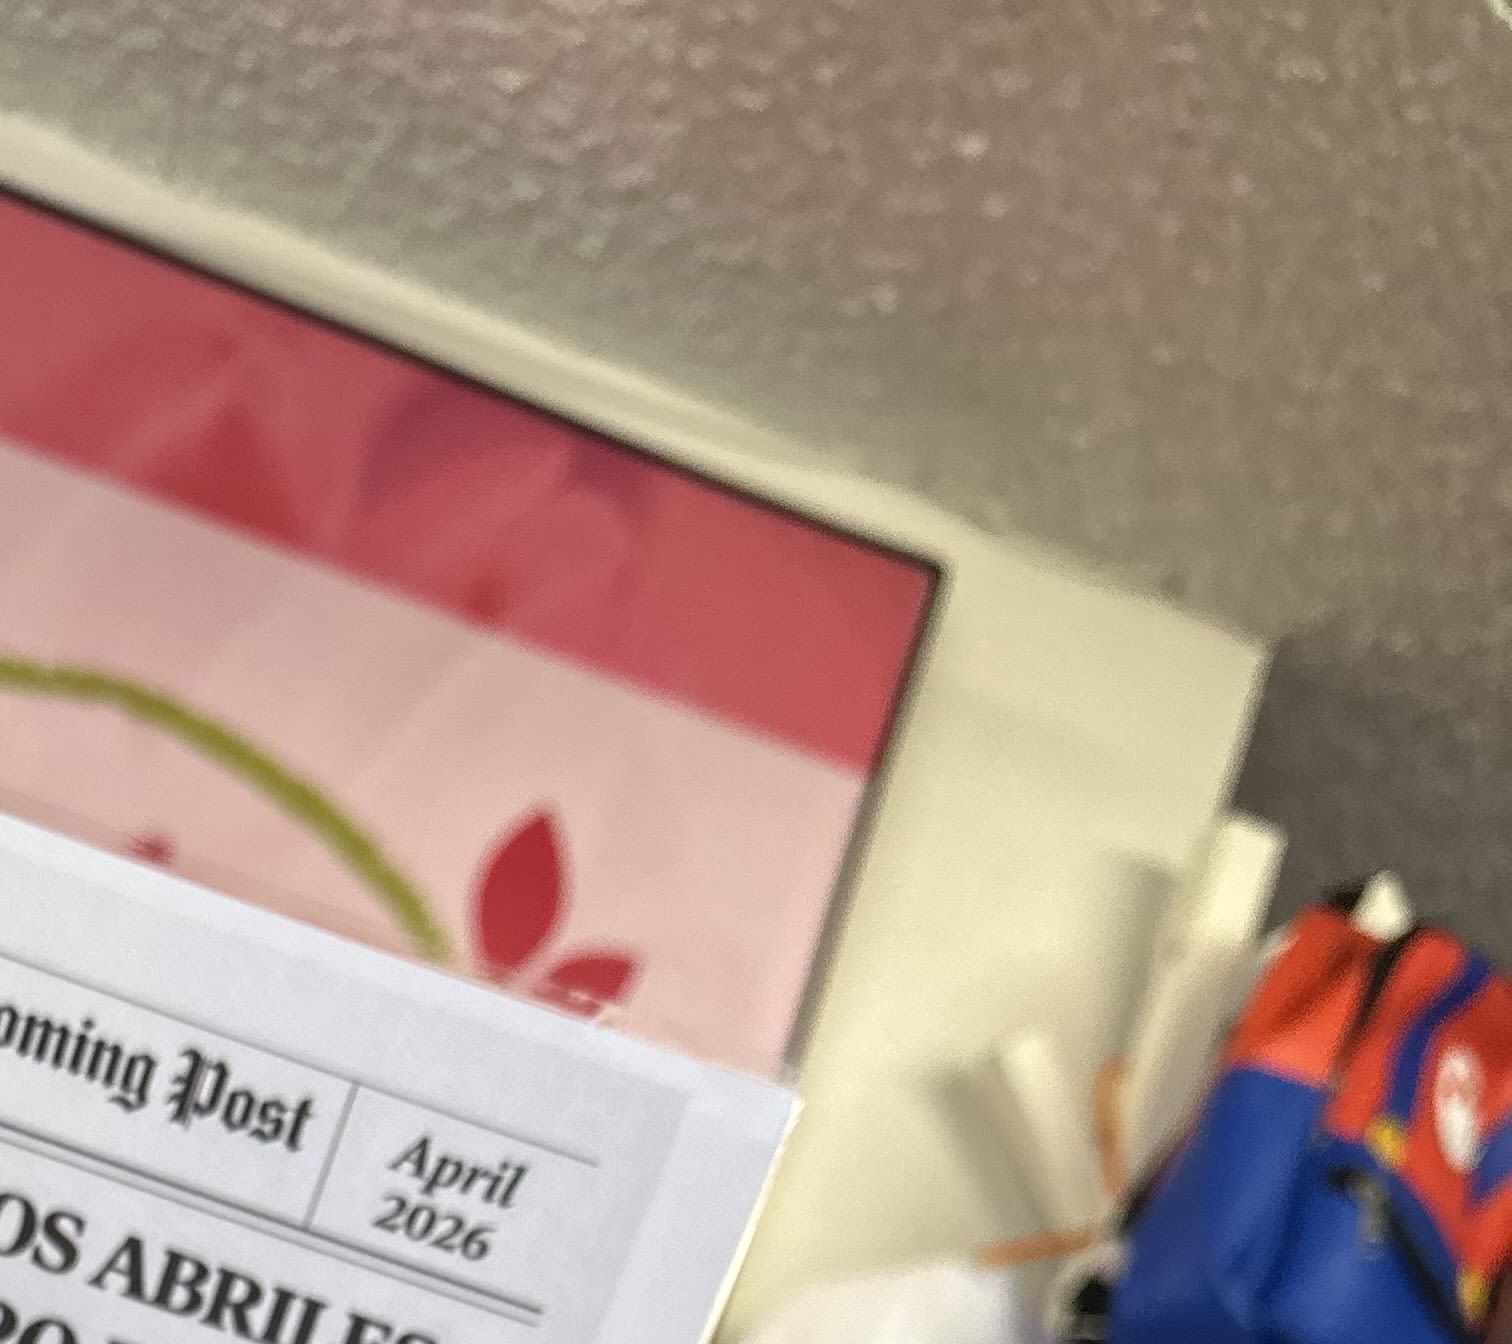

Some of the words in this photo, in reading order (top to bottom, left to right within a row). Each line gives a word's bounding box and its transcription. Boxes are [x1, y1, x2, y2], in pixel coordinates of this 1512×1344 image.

[165, 1047, 317, 1152] Post
[389, 1136, 528, 1208] April
[373, 1194, 496, 1262] 2026
